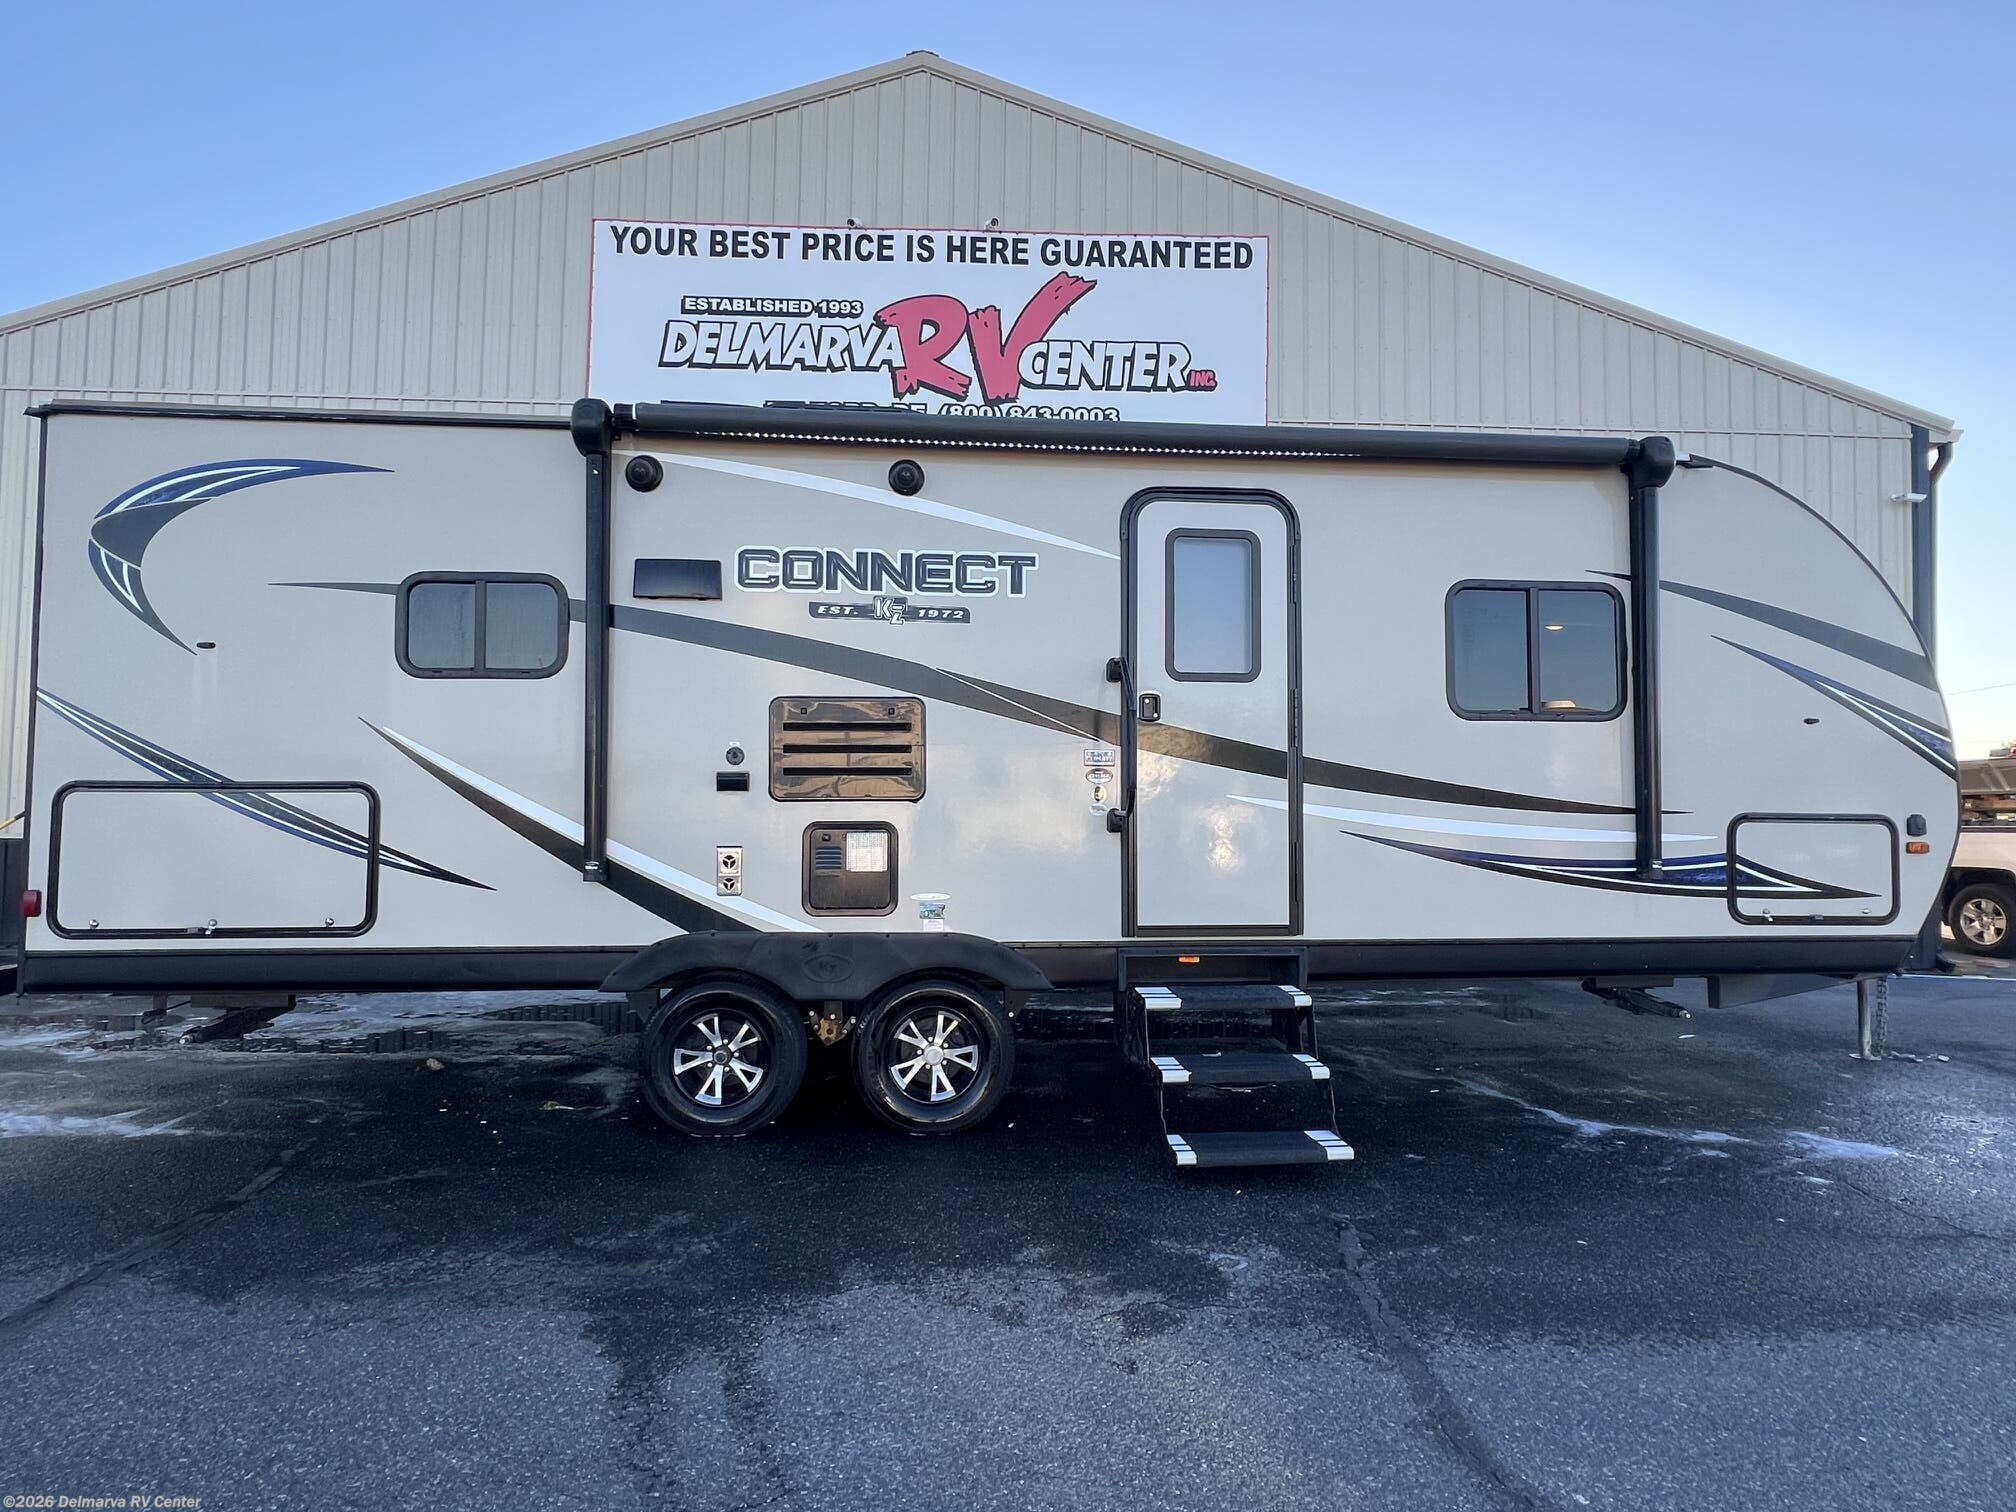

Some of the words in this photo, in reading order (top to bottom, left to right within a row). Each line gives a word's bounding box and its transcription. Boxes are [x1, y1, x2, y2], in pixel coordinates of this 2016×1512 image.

[610, 225, 698, 257] YOUR
[709, 230, 791, 260] BEST
[801, 232, 895, 262] PRICE
[906, 234, 935, 263] IS
[946, 235, 1030, 265] HERE
[1040, 238, 1254, 269] GUARANTEED
[682, 296, 815, 316] ESTABLISHED
[817, 300, 863, 317] 1993
[658, 320, 906, 373] DELMARVA
[873, 271, 1098, 404] RV
[1018, 340, 1191, 392] CENTER
[736, 547, 1038, 597] CONNECT
[817, 605, 859, 615] EST.
[918, 608, 965, 619] 1972
